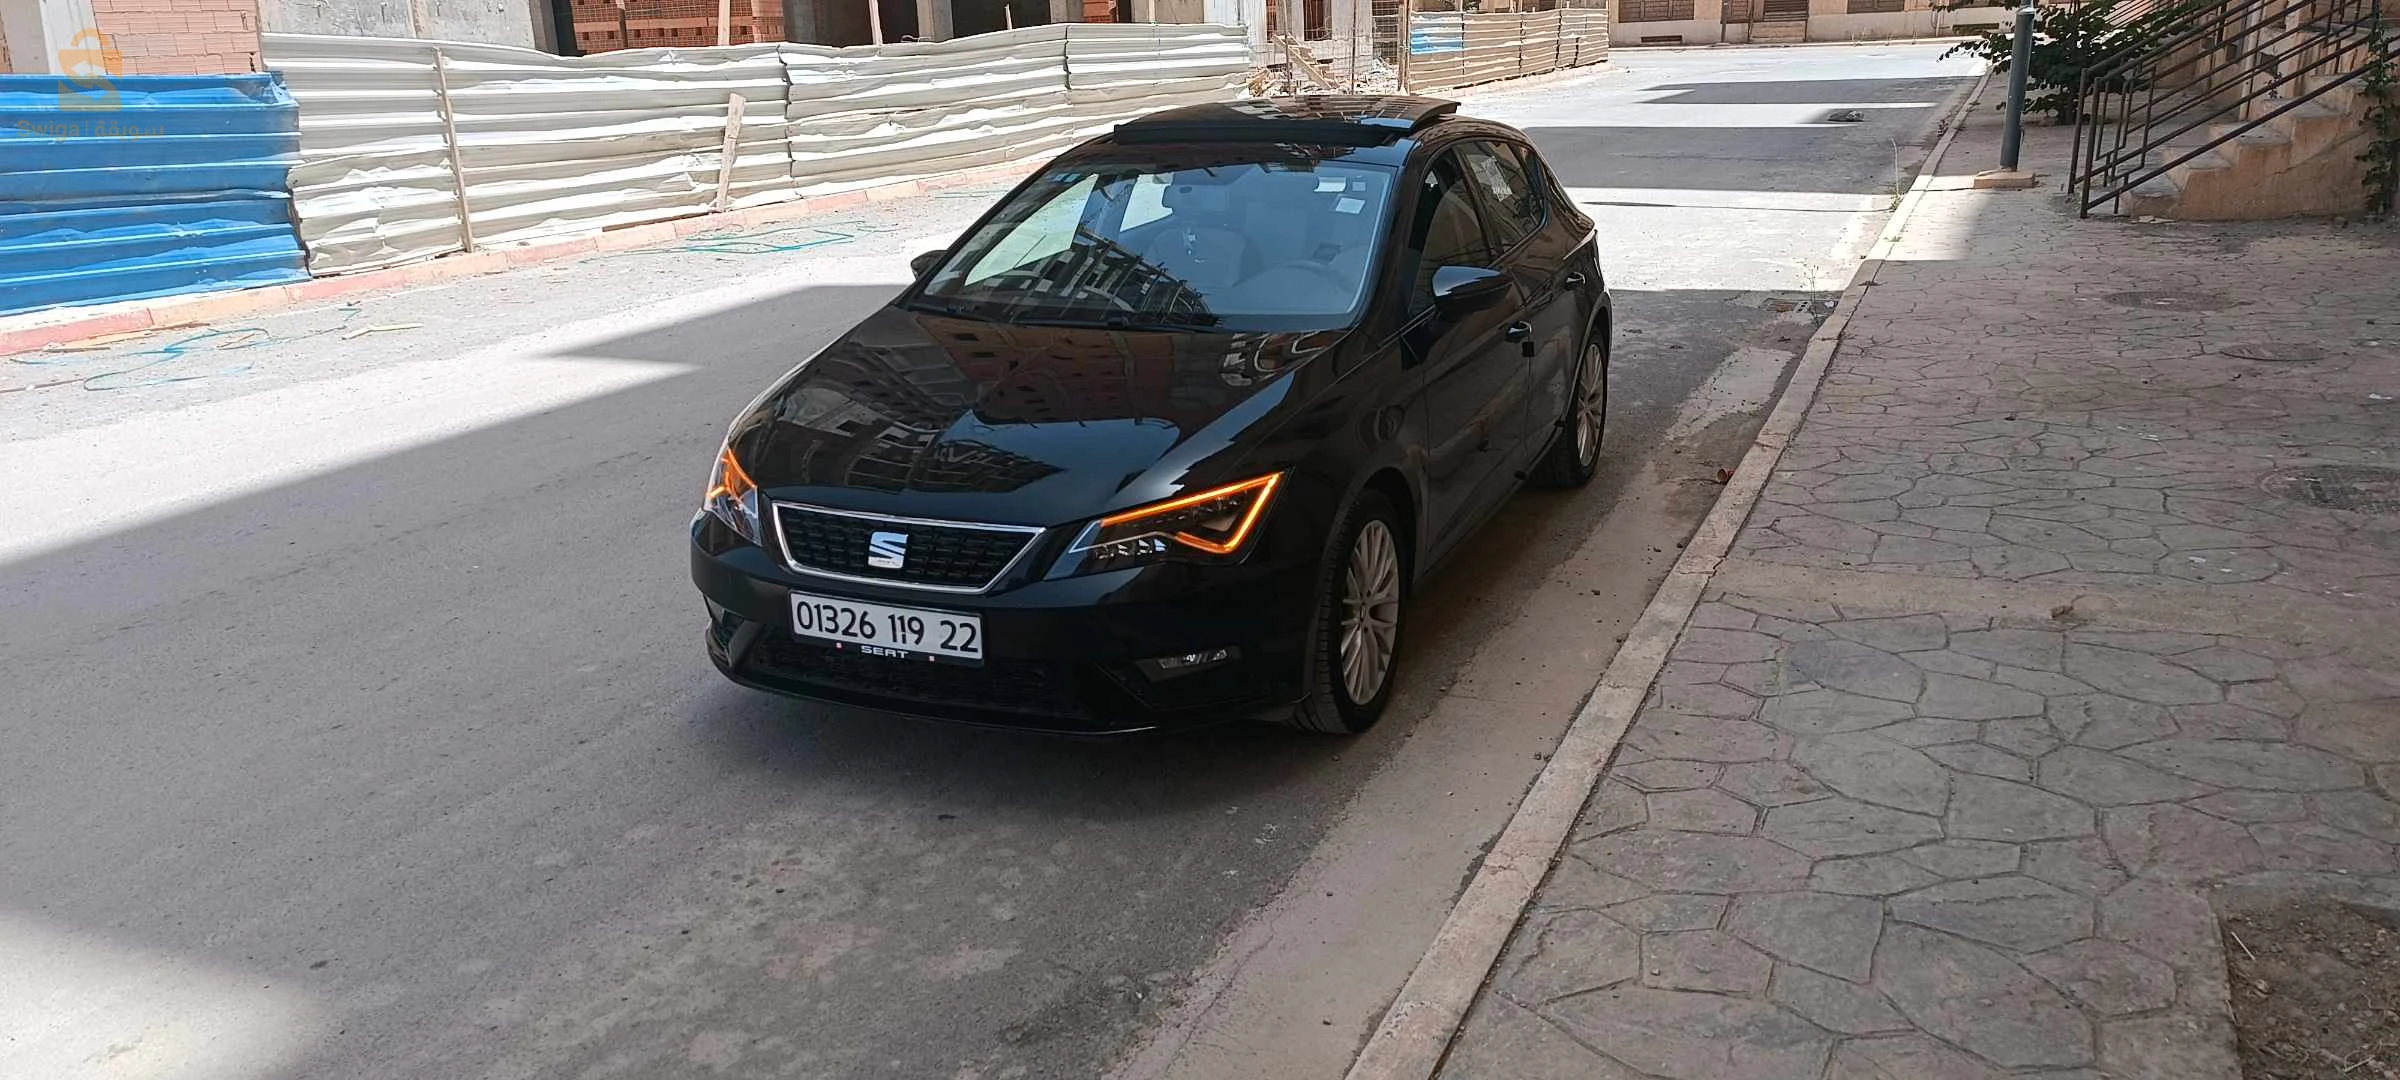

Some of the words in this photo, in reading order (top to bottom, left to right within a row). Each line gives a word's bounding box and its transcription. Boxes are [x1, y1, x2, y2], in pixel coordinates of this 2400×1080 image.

[796, 601, 876, 639] 01326
[888, 613, 925, 646] 119
[939, 620, 979, 653] 22
[861, 645, 909, 659] SEAT
